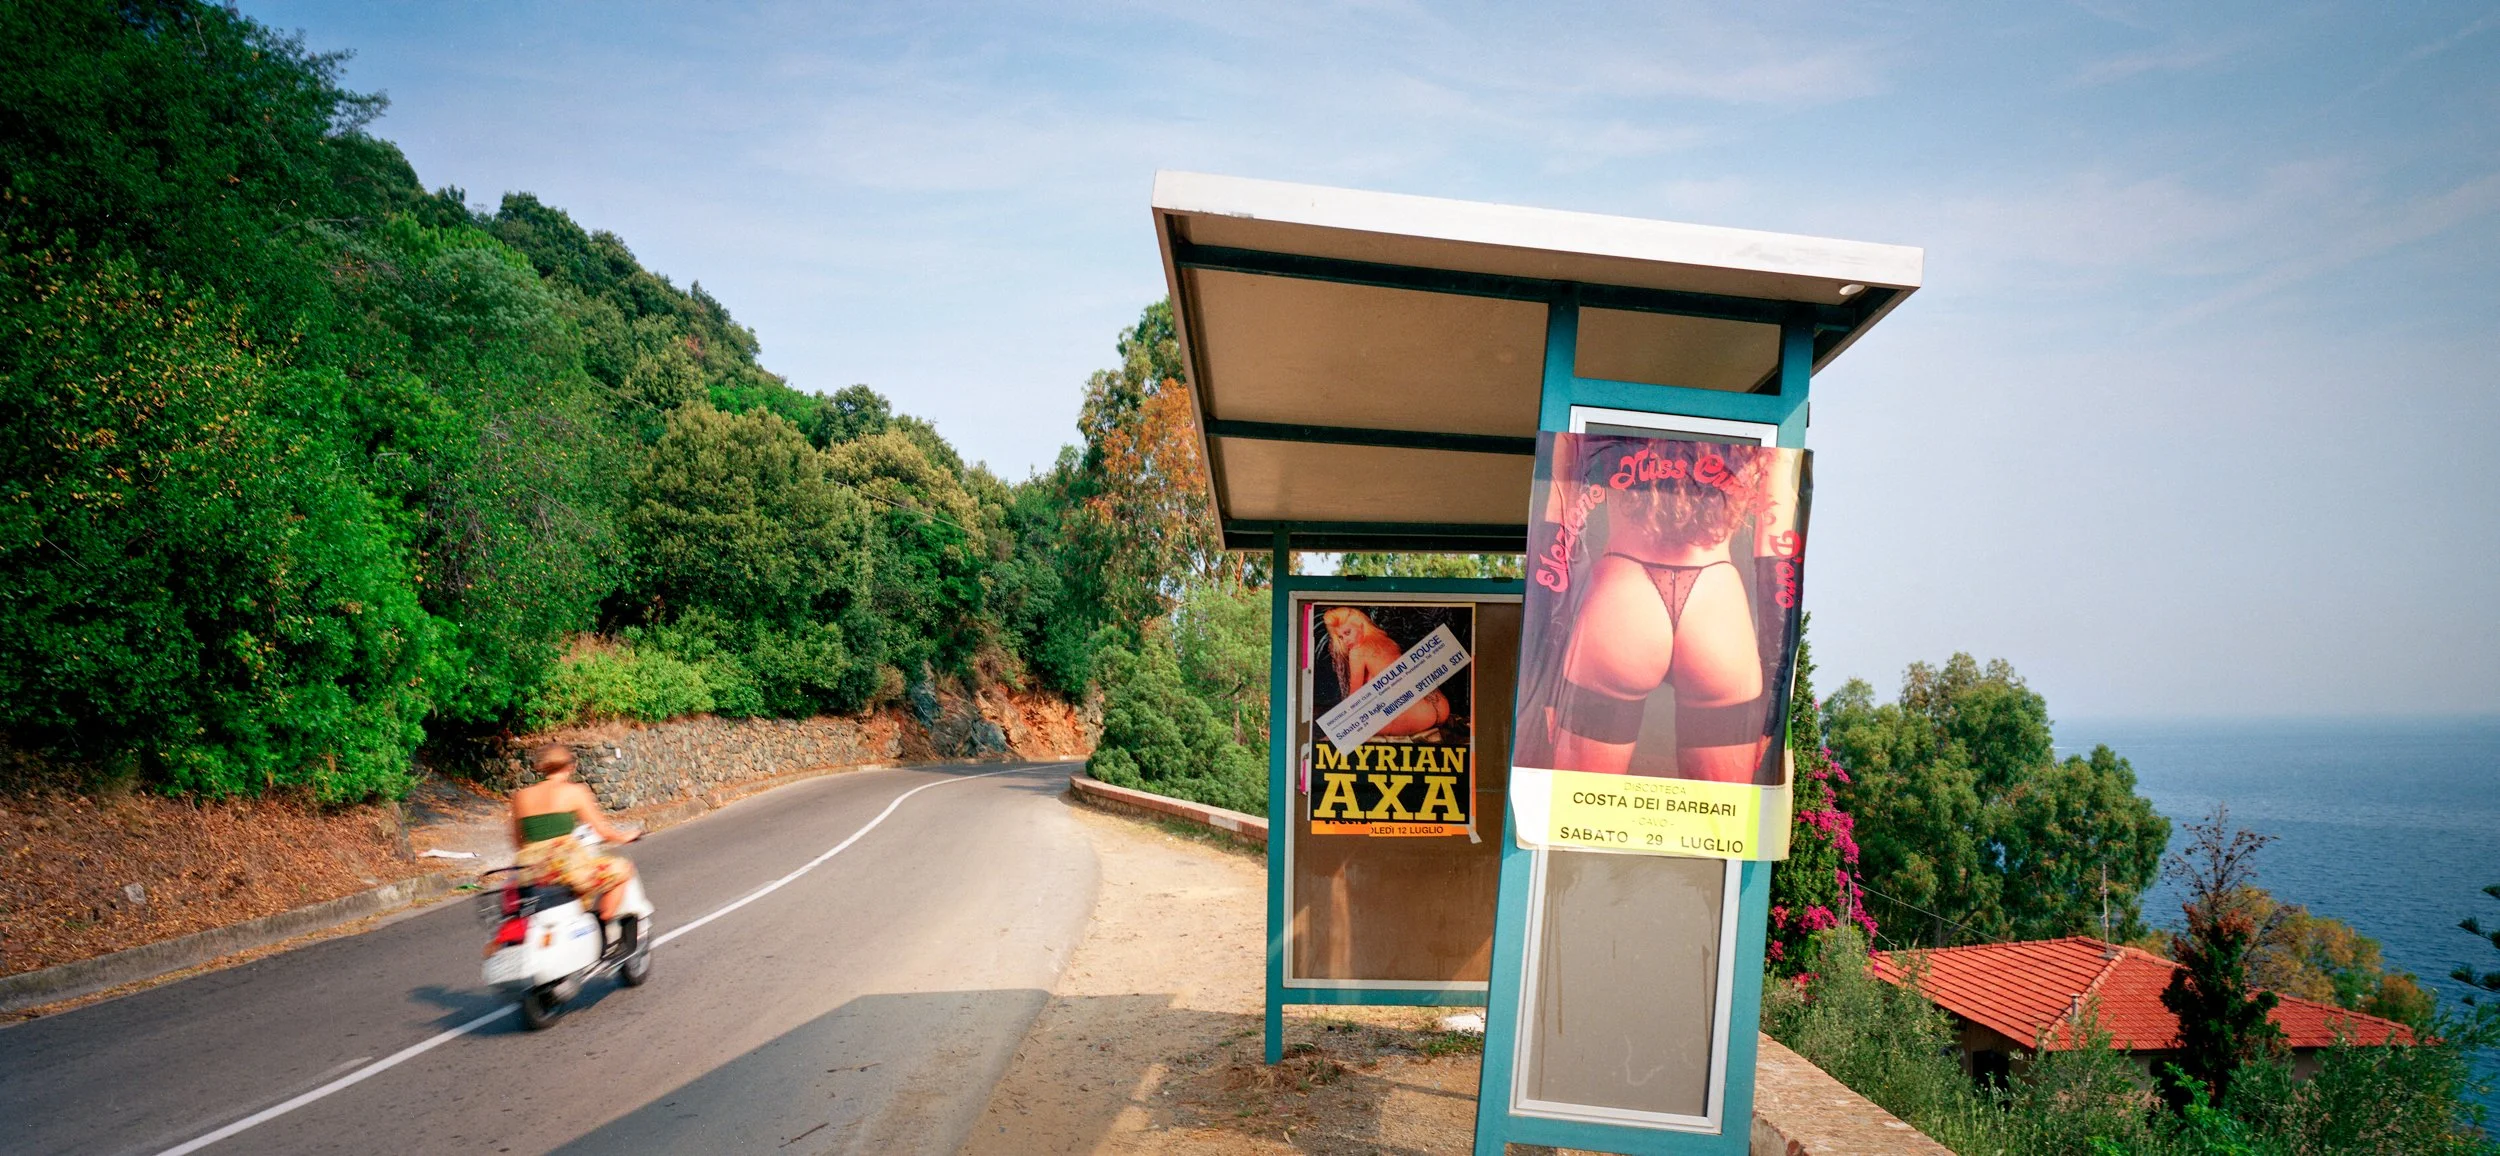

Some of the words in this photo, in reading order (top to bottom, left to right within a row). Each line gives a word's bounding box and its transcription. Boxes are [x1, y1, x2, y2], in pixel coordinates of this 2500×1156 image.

[1609, 449, 1687, 490] Miss
[1372, 661, 1407, 691] MOULIN
[1409, 634, 1443, 663] ROUGE
[1382, 690, 1415, 717] NUOVISSIMO
[1415, 664, 1449, 692] SPETTACOLO
[1449, 651, 1465, 666] SEXY
[1336, 720, 1360, 741] Sabato
[1359, 713, 1369, 723] 29
[1369, 702, 1387, 716] luglio
[1315, 743, 1467, 773] MYRIAN
[1313, 772, 1466, 822] AXA
[1573, 792, 1628, 808] COSTA
[1634, 797, 1660, 811] DEI
[1666, 799, 1737, 817] BARBARI
[1624, 782, 1687, 795] DISCOTECA
[1398, 826, 1407, 834] 12
[1409, 826, 1444, 835] LUGLIO
[1560, 826, 1629, 844] SABATO
[1646, 833, 1663, 846] 29
[1680, 836, 1744, 854] LUGLIO
